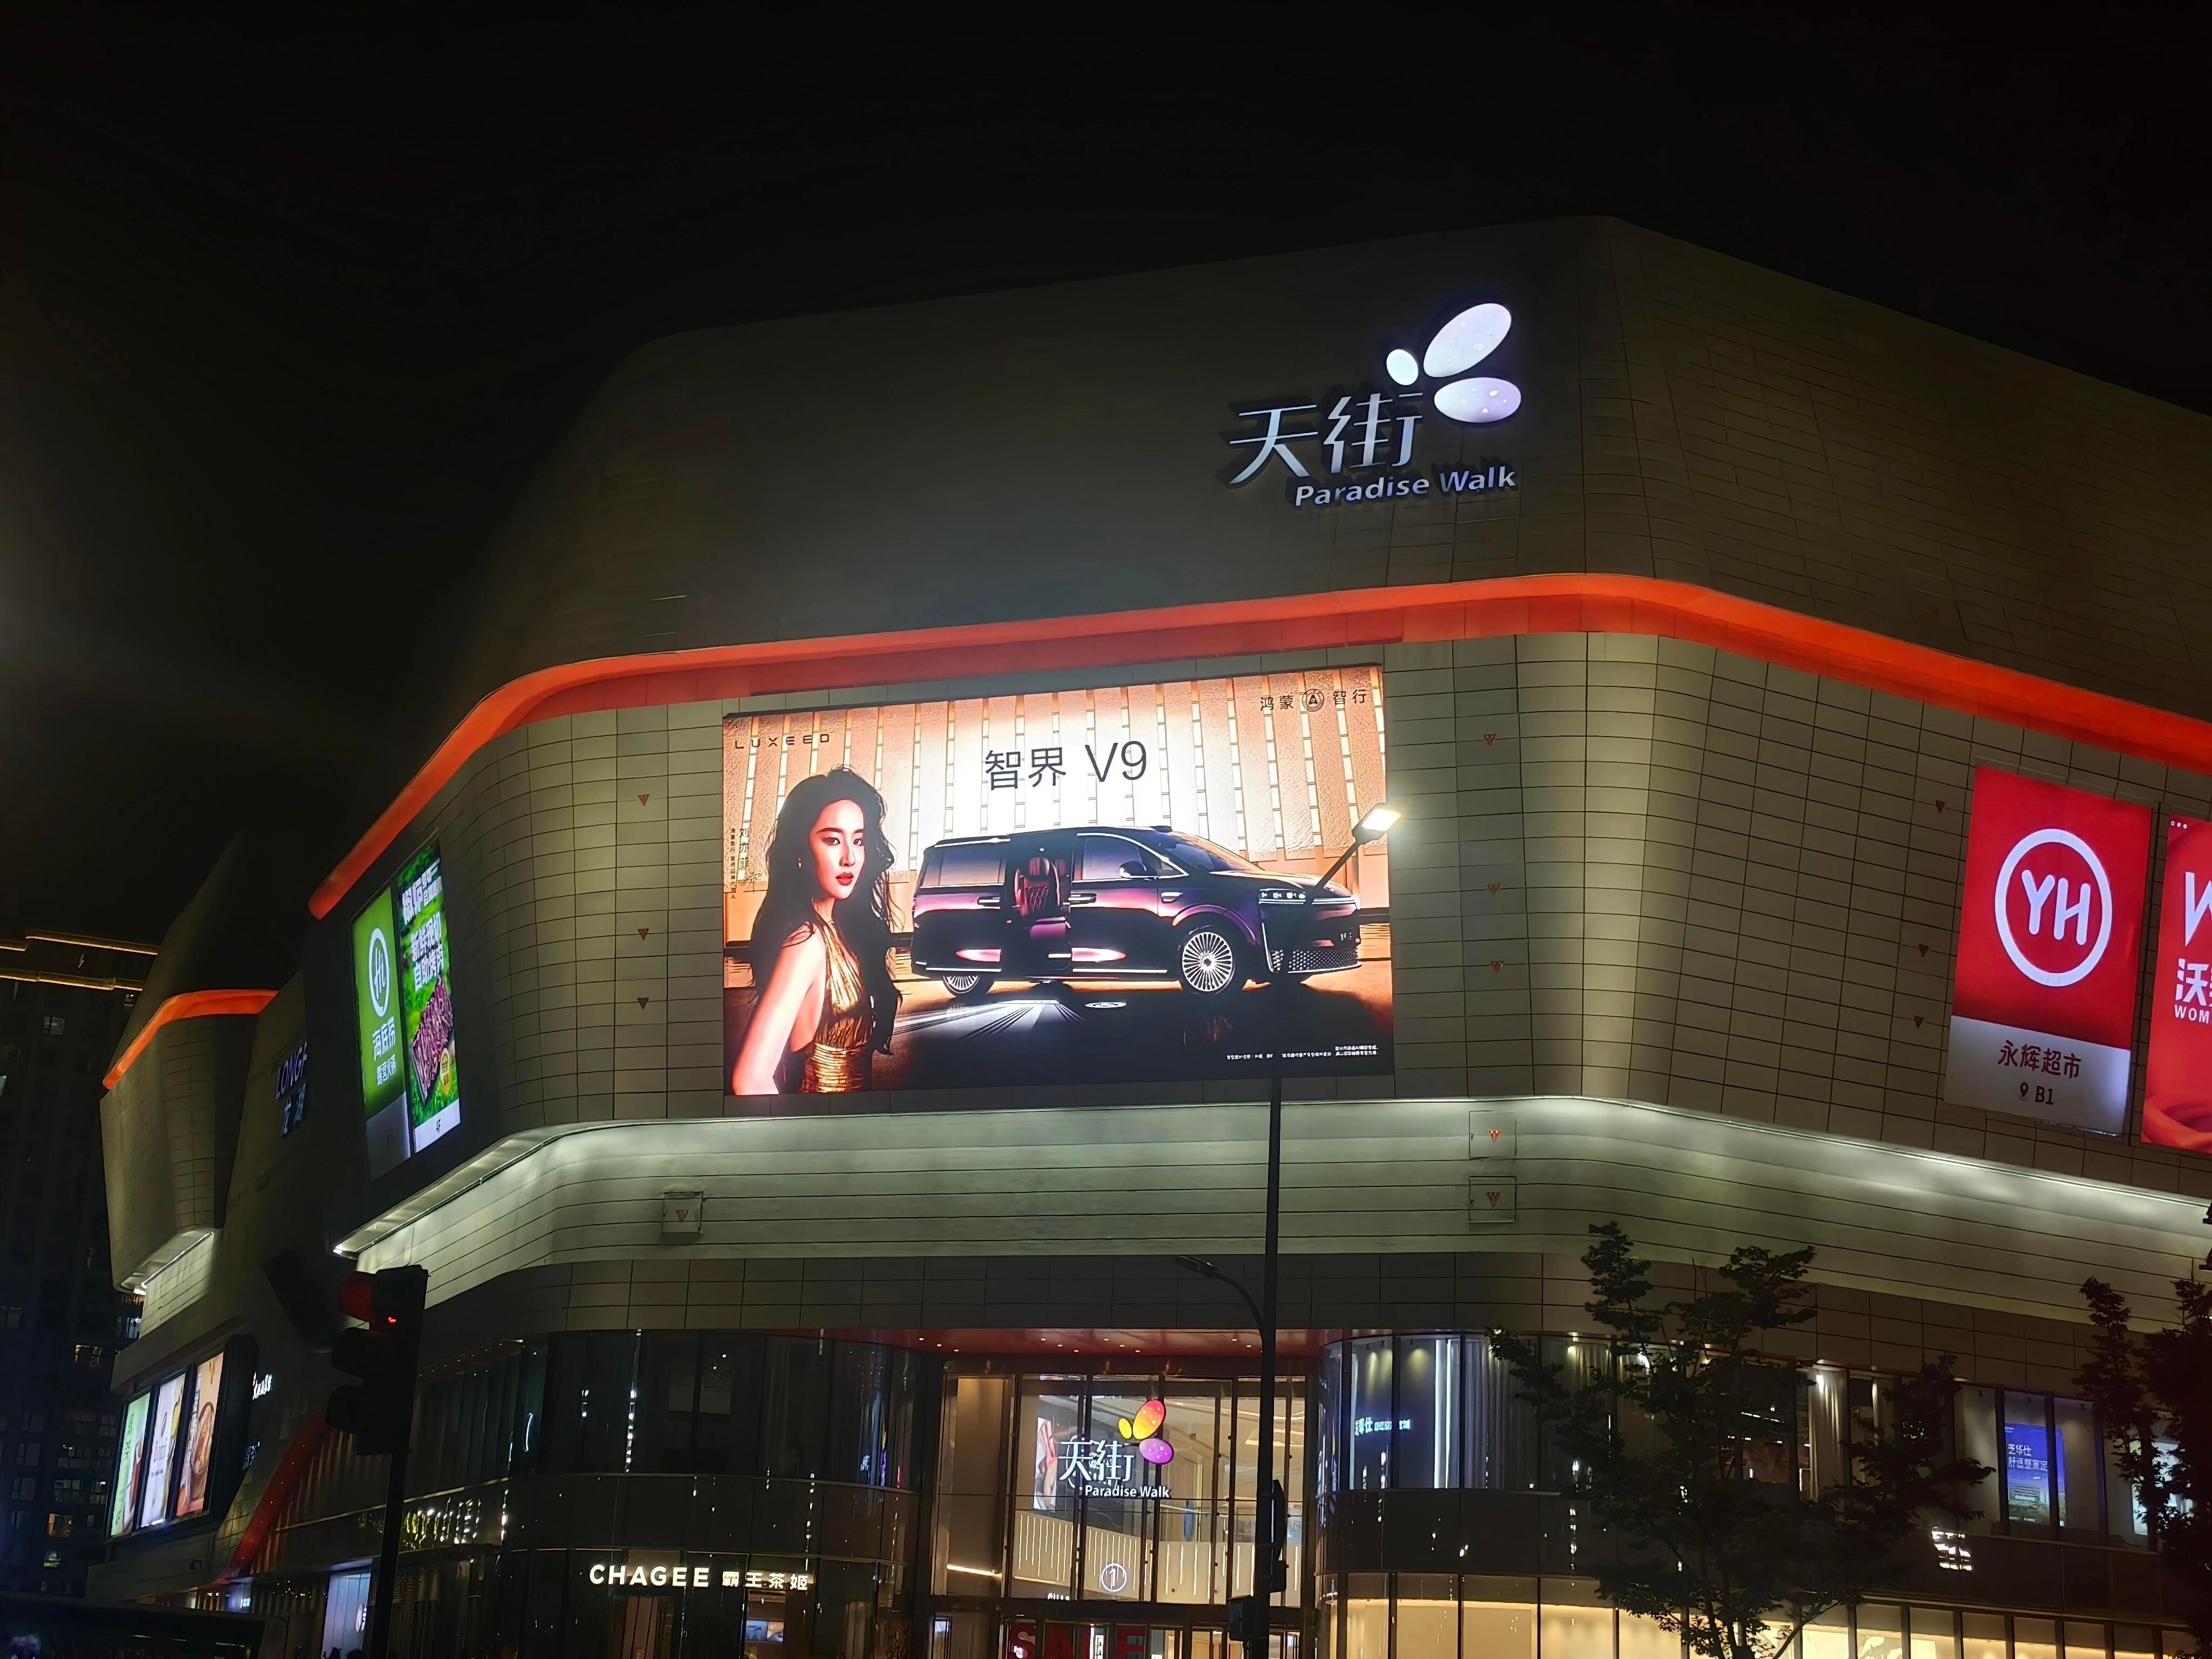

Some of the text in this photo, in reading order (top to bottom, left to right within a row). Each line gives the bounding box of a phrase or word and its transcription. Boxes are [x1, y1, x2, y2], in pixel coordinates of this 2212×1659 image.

[1229, 392, 1424, 484] 天街
[1295, 466, 1517, 507] Paradise Walk
[1260, 689, 1367, 711] 鸿蒙 智行
[734, 732, 831, 750] LUXEED
[984, 740, 1148, 791] 智界 V9
[2021, 869, 2091, 946] YH
[414, 943, 444, 992] 自助烤肉
[2175, 958, 2212, 1007] 沃
[2174, 1004, 2210, 1024] WOM
[1998, 1039, 2082, 1080] 永辉超市
[2034, 1085, 2055, 1105] B1
[1057, 1439, 1135, 1482] 天街
[1084, 1485, 1170, 1498] Paradise Walk
[589, 1564, 710, 1588] CHAGEE
[721, 1570, 808, 1591] 霸王茶姬
